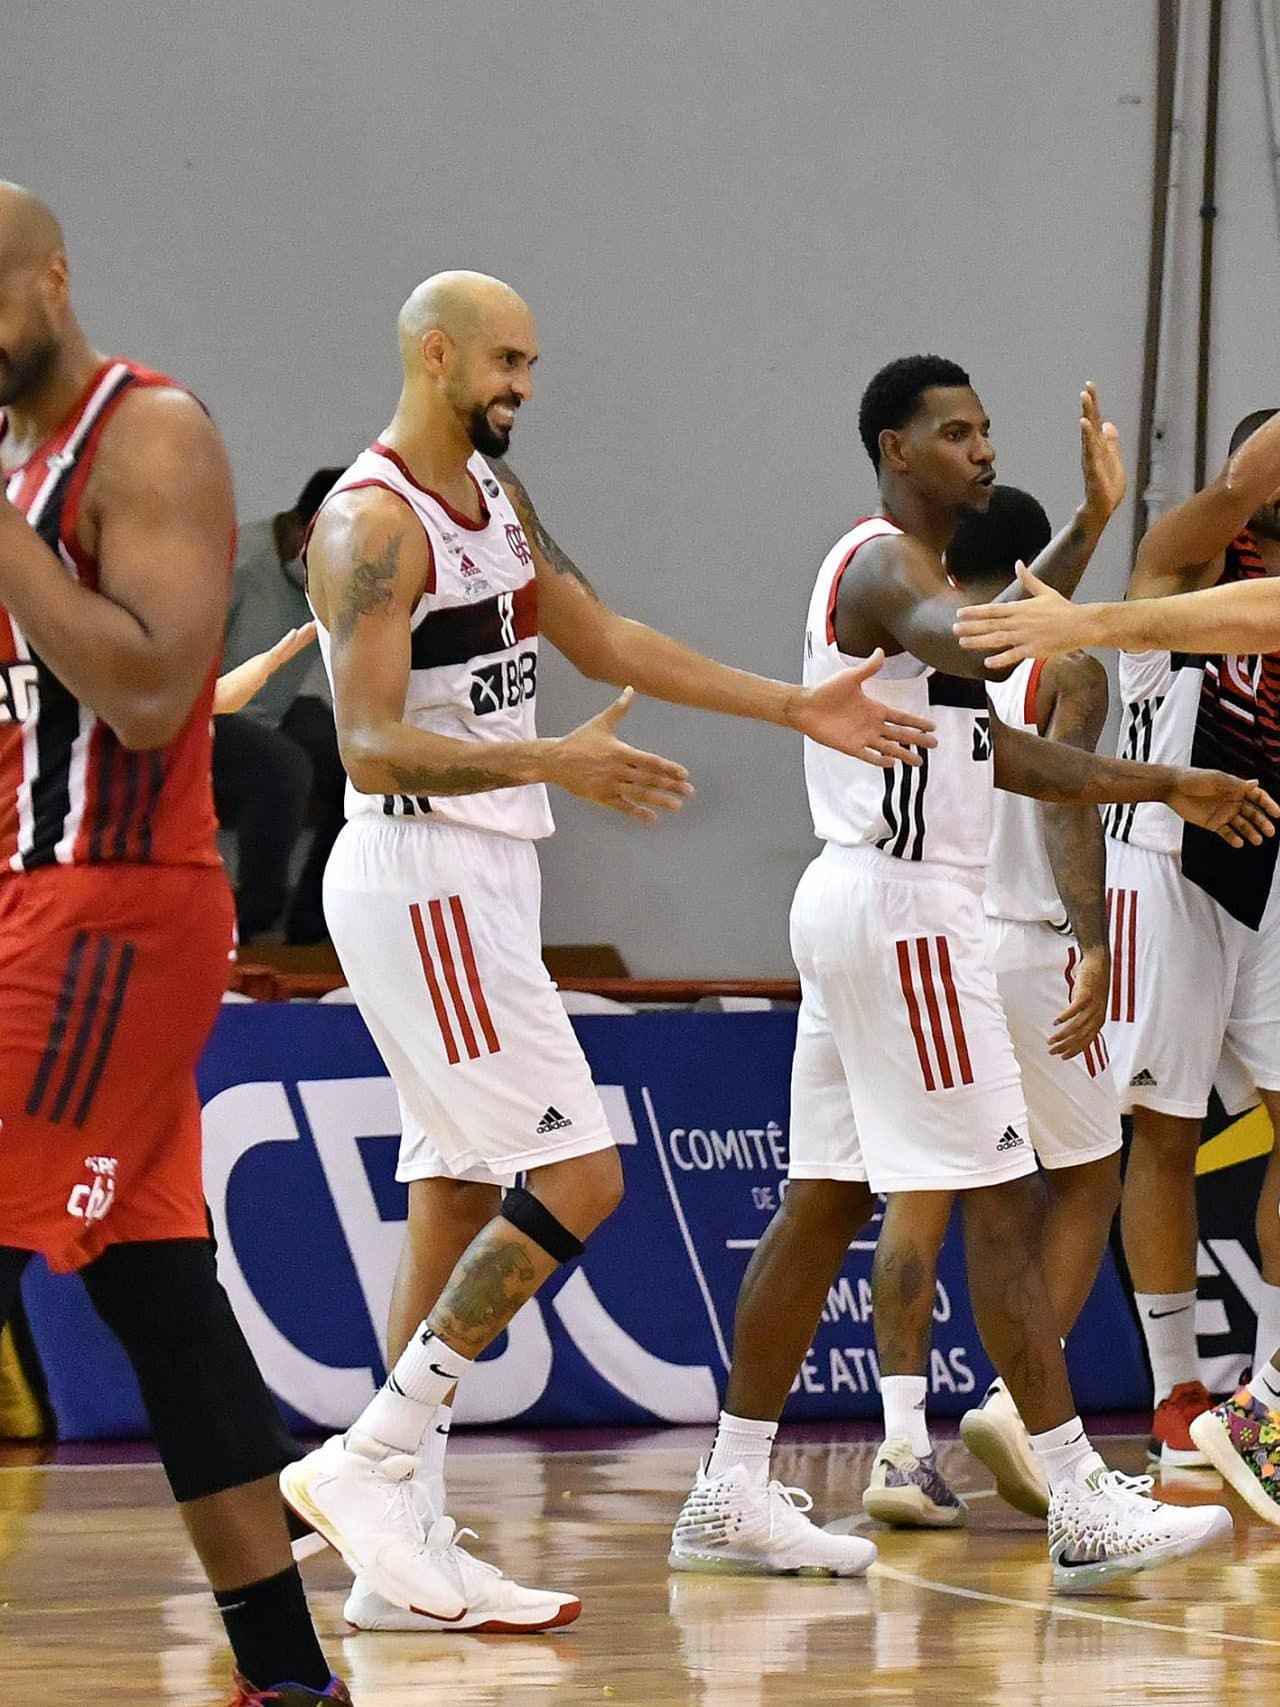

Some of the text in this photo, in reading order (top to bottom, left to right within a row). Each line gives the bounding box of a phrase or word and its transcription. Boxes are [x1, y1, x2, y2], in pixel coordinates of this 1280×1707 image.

[536, 1118, 573, 1134] adidas
[669, 1120, 789, 1170] COMITÊ
[996, 1138, 1025, 1151] adidas
